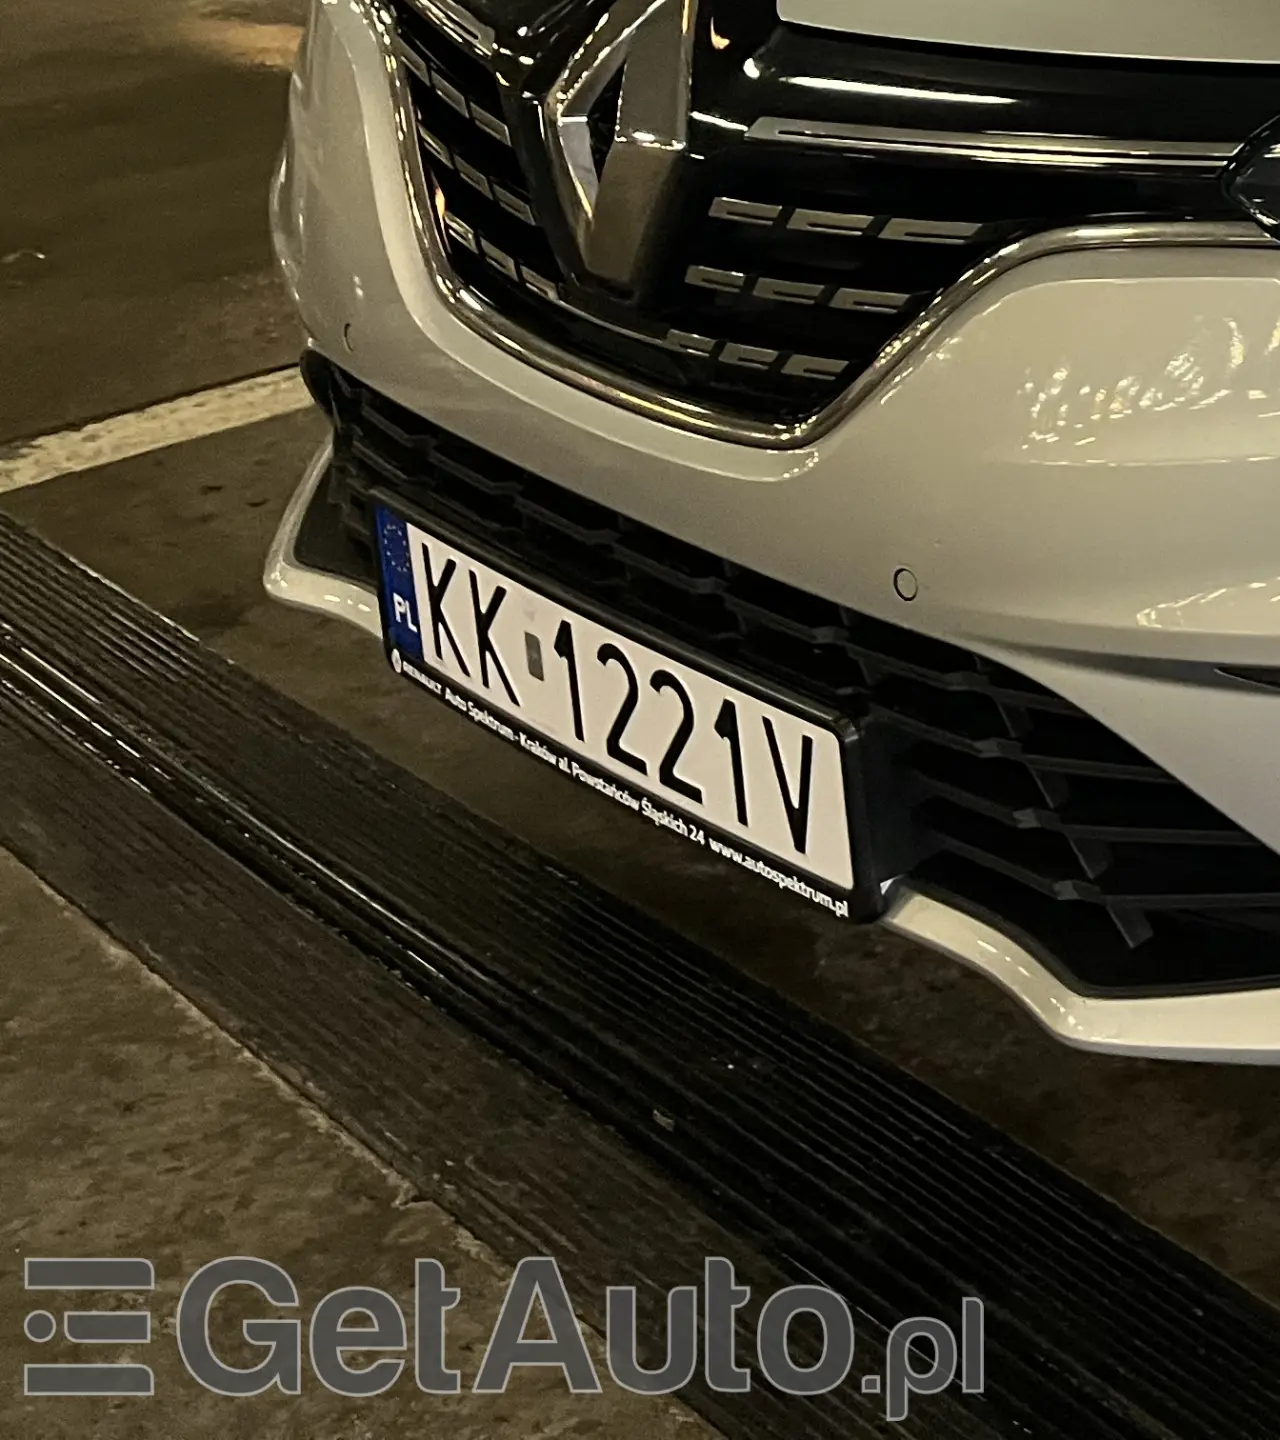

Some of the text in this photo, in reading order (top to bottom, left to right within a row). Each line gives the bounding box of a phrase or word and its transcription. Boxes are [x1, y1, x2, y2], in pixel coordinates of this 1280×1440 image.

[393, 592, 418, 634] PL
[422, 542, 814, 856] KK 1221V
[444, 687, 467, 712] Auto
[467, 701, 514, 741] Spektrum
[519, 731, 557, 765] Kraków
[571, 761, 640, 811] Powstańców
[641, 797, 688, 837] Śląskich
[689, 824, 705, 845] 24
[708, 838, 849, 918] www.autospektrum.pl
